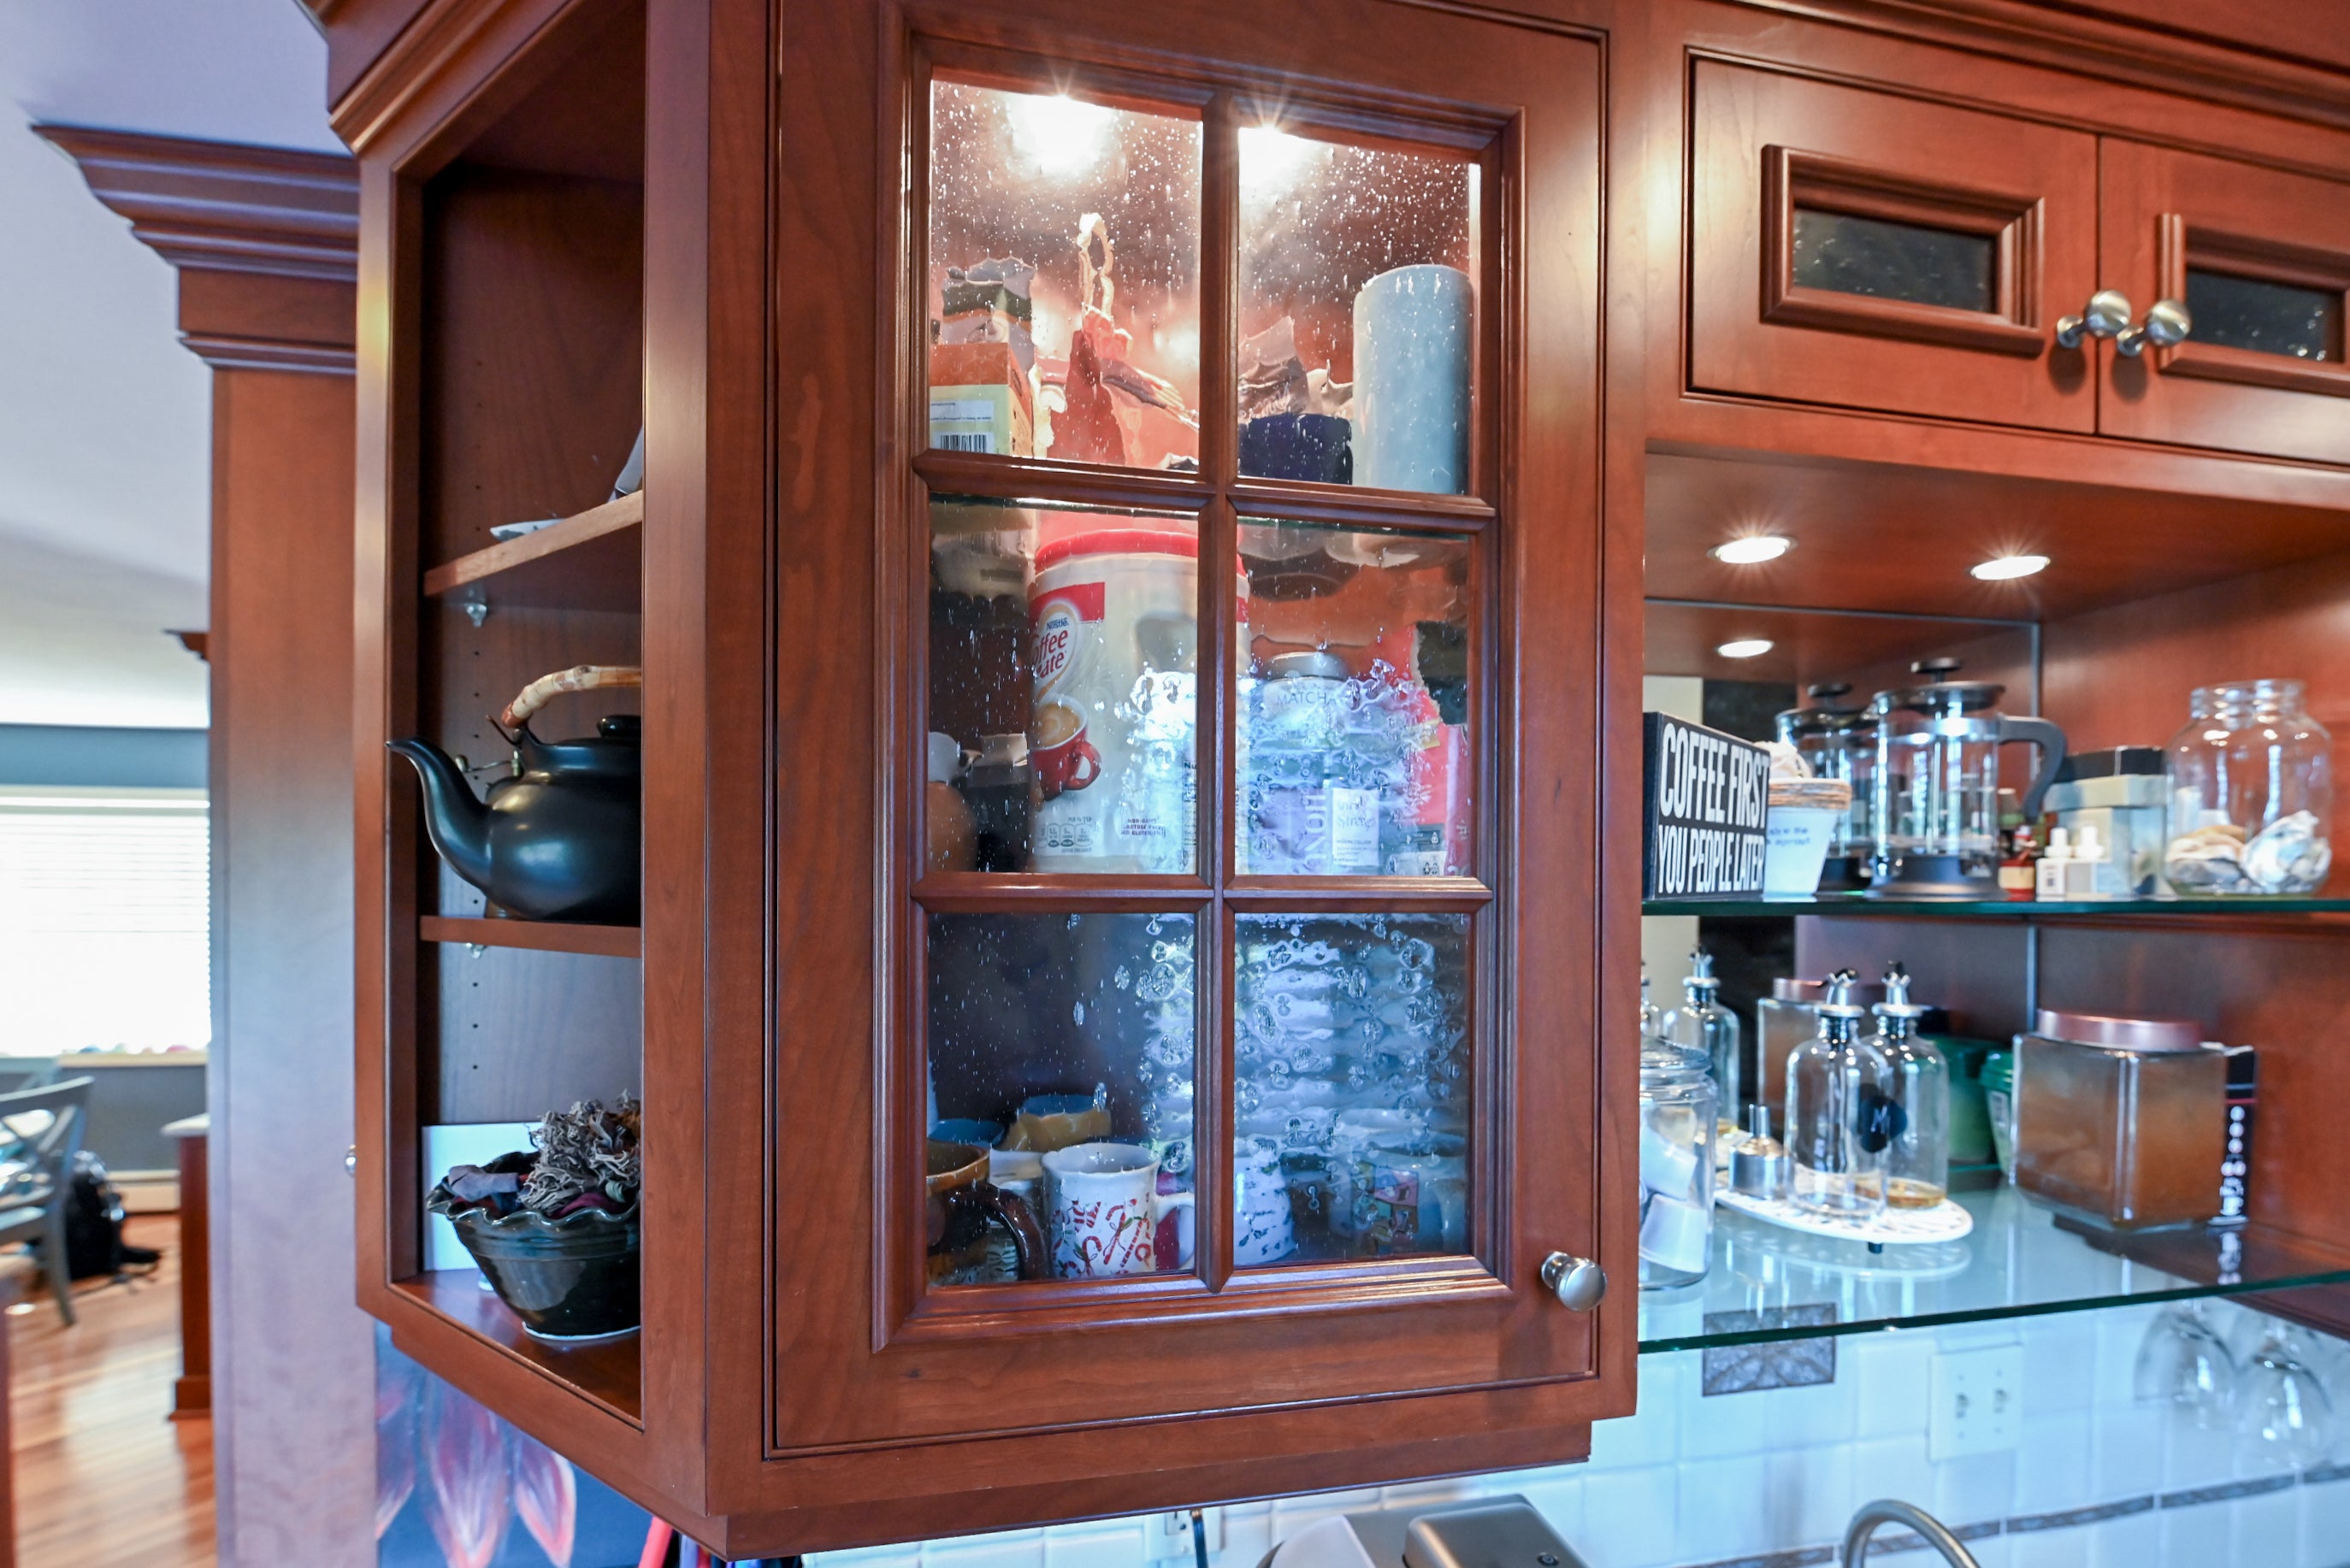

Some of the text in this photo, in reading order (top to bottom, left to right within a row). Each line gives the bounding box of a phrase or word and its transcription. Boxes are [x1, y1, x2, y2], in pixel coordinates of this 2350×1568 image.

[1036, 652, 1065, 678] ate
[1277, 691, 1337, 706] MATCHA
[1660, 722, 1770, 829] COFFEE FIRST
[1658, 825, 1767, 893] YOU PEOPLE LATER
